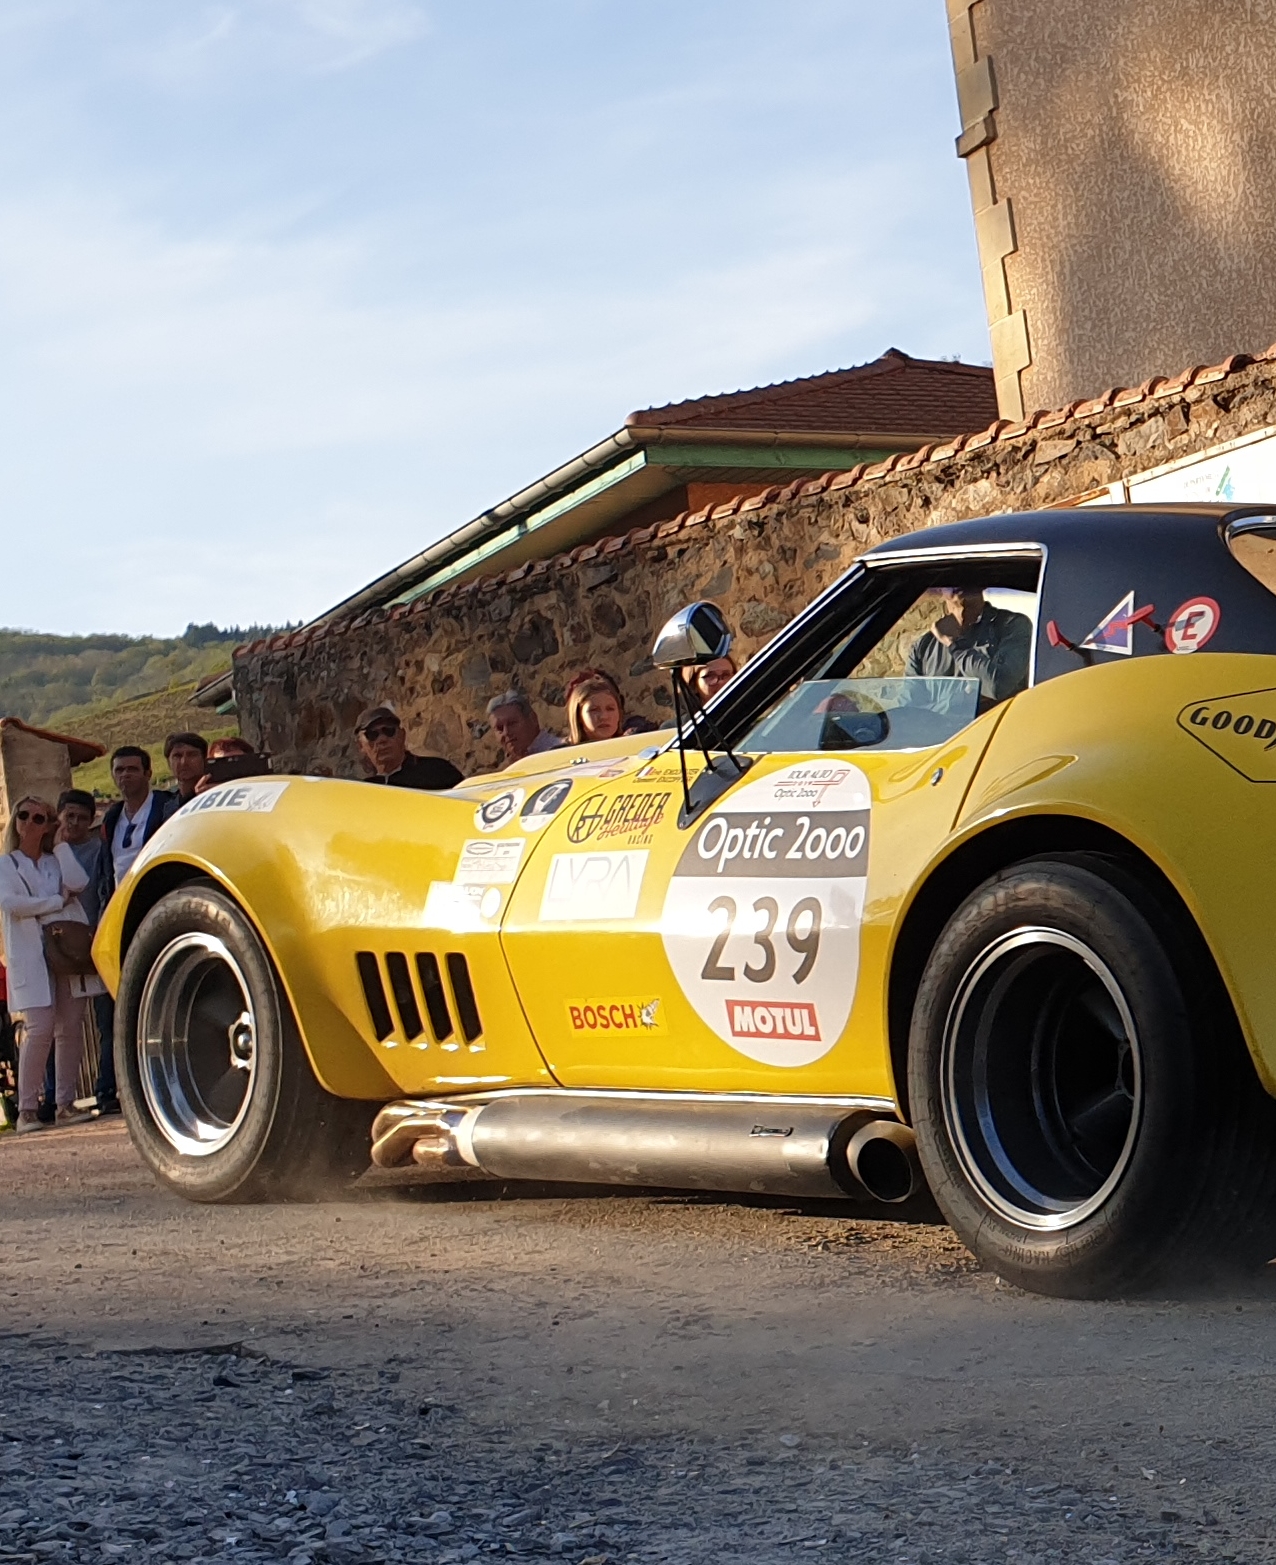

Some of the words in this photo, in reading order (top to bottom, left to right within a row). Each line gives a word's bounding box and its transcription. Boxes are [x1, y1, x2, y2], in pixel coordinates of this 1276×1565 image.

[1181, 611, 1205, 640] E
[604, 792, 672, 825] GREDER
[697, 816, 784, 873] Optic
[785, 816, 865, 860] 2000
[701, 895, 822, 985] 239
[569, 1004, 638, 1030] BOSCH
[733, 1005, 816, 1036] MOTUL
